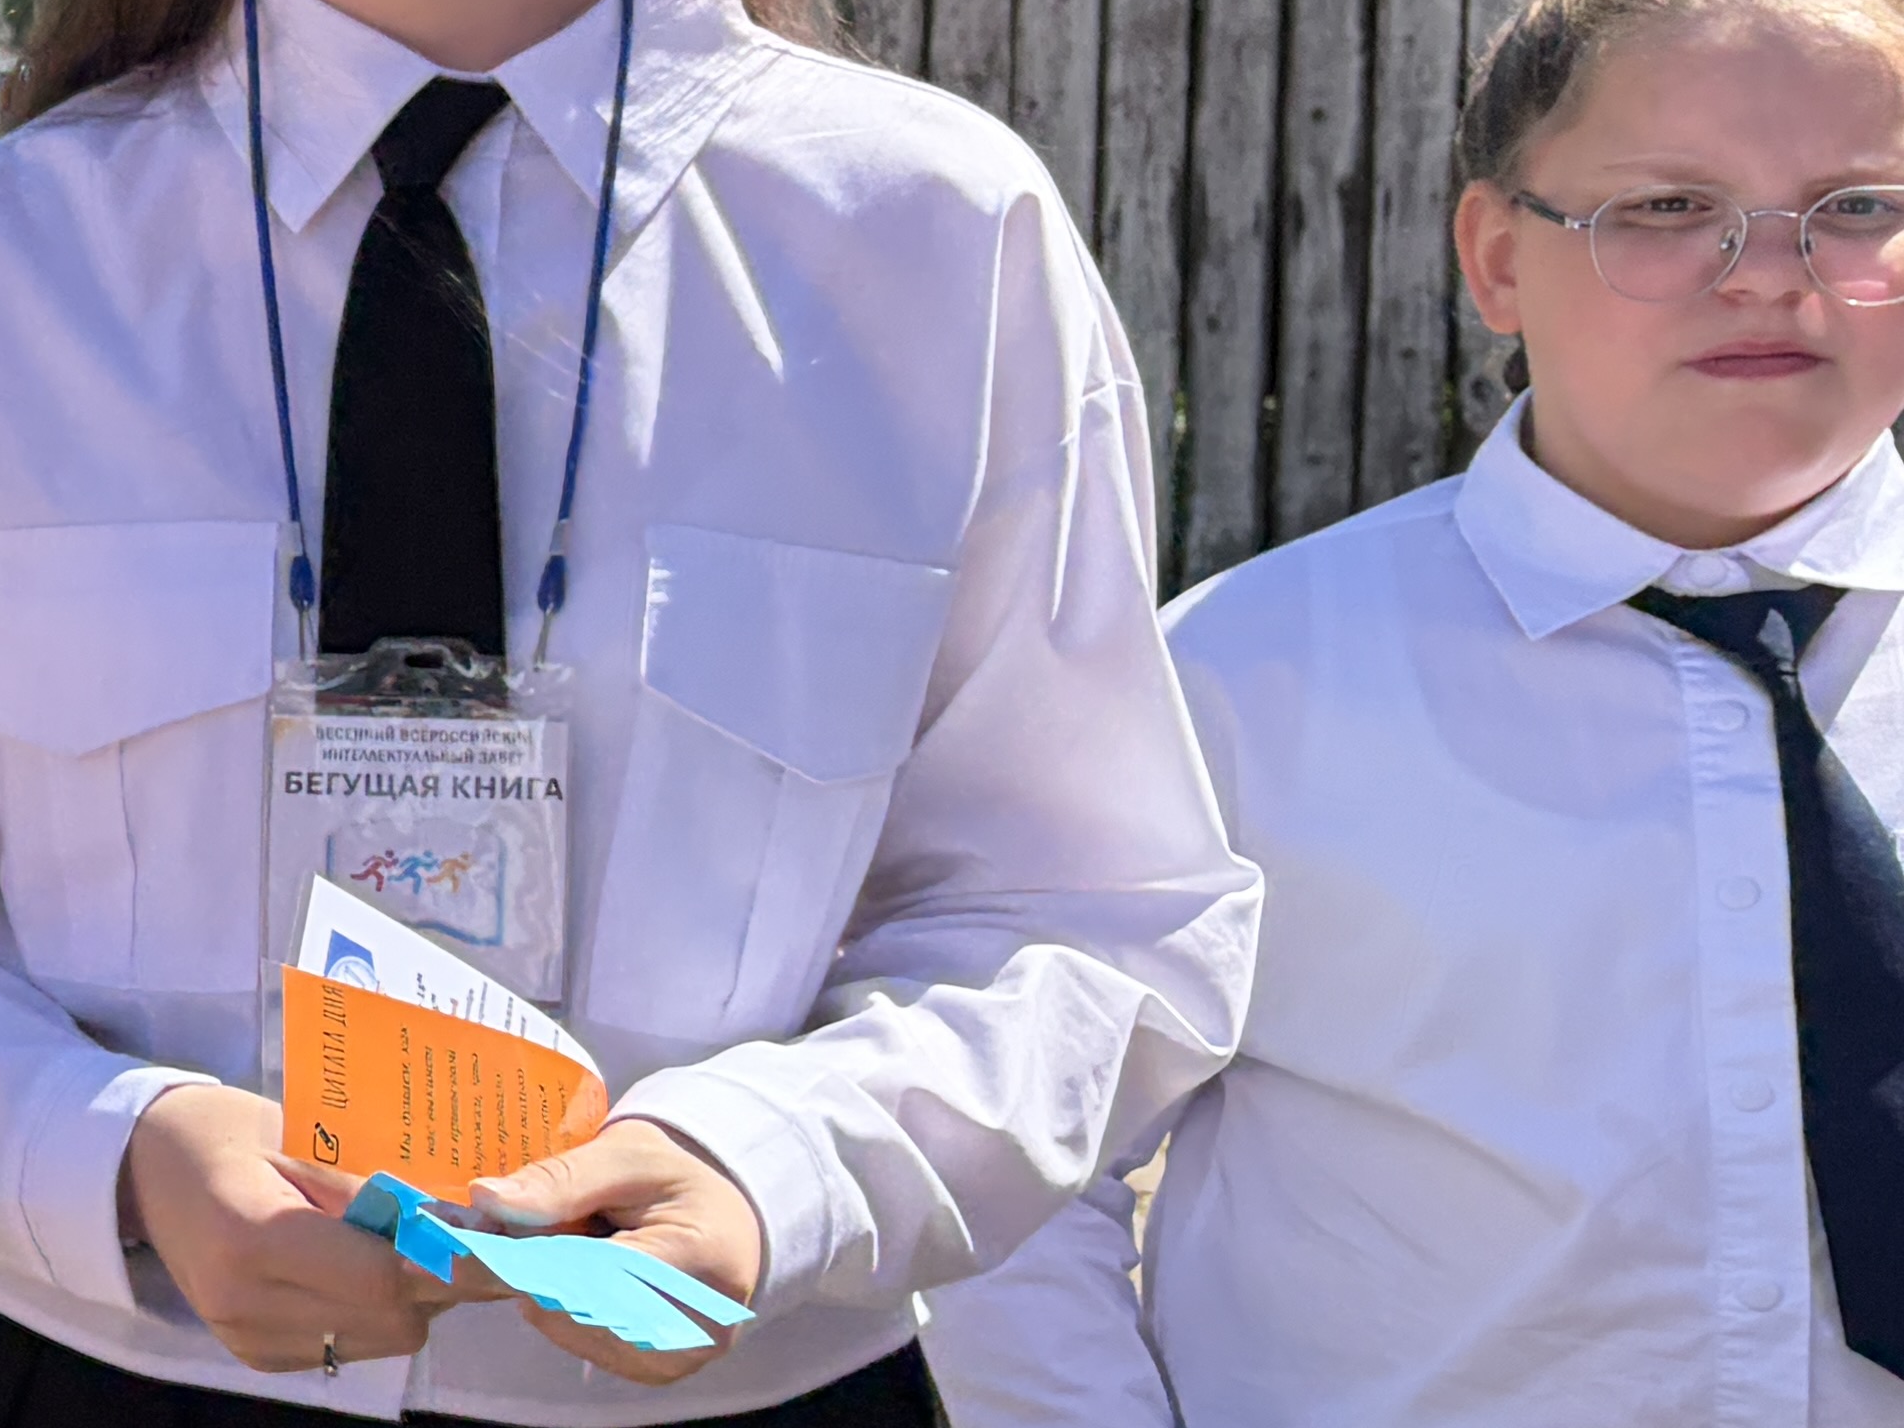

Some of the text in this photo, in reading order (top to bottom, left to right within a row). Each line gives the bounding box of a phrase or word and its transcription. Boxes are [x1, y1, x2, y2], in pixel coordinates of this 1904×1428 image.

[284, 771, 564, 801] БЕГУЩАЯ КНИГА
[322, 983, 349, 1110] ЦИТАТА ДНЯ
